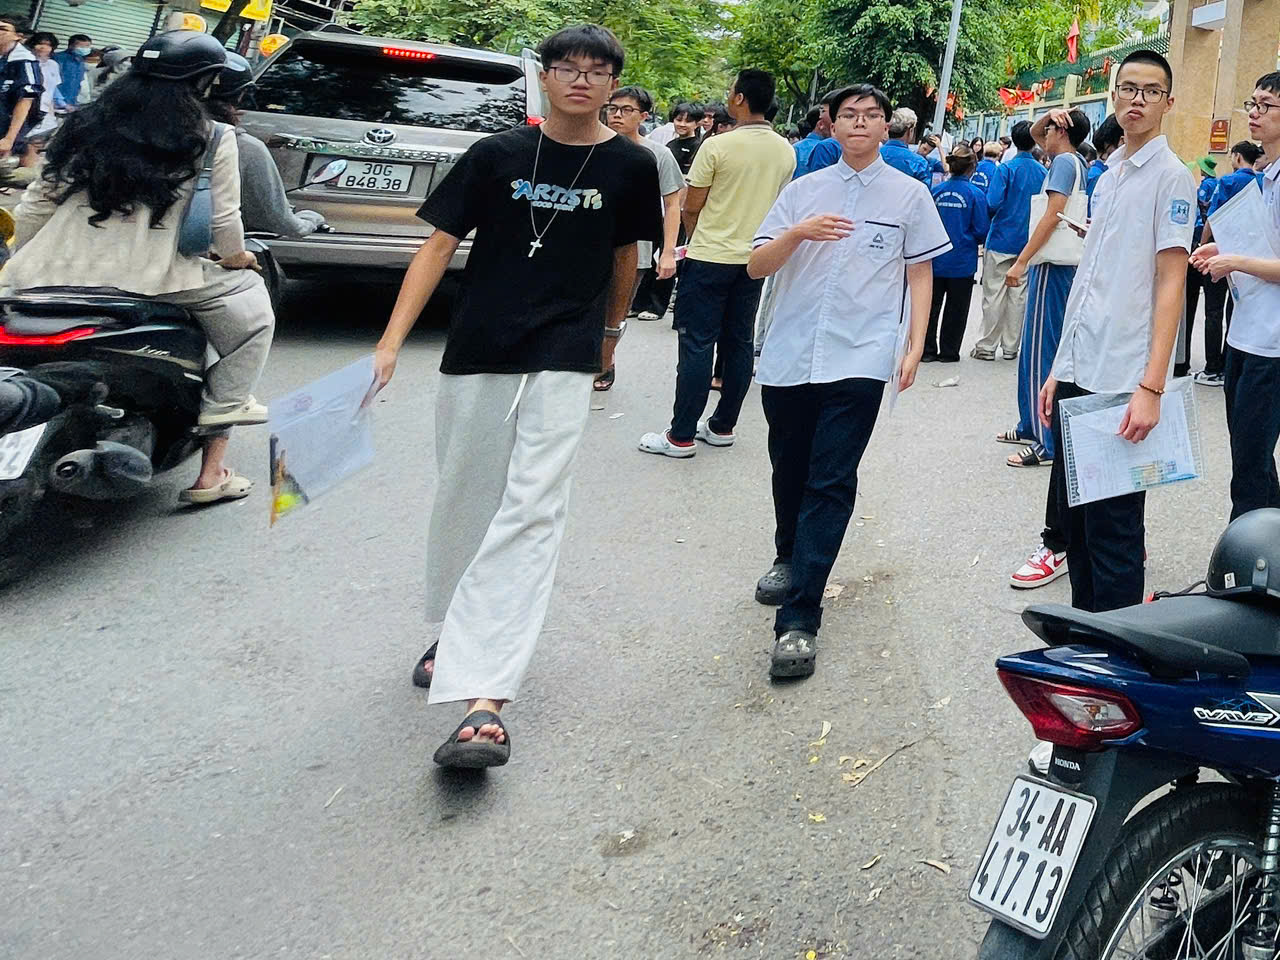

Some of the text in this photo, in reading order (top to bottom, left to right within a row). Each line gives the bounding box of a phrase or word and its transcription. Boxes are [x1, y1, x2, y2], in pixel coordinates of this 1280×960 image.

[362, 163, 393, 176] 30G
[345, 176, 402, 190] 848.38
[1055, 757, 1081, 771] HONDA
